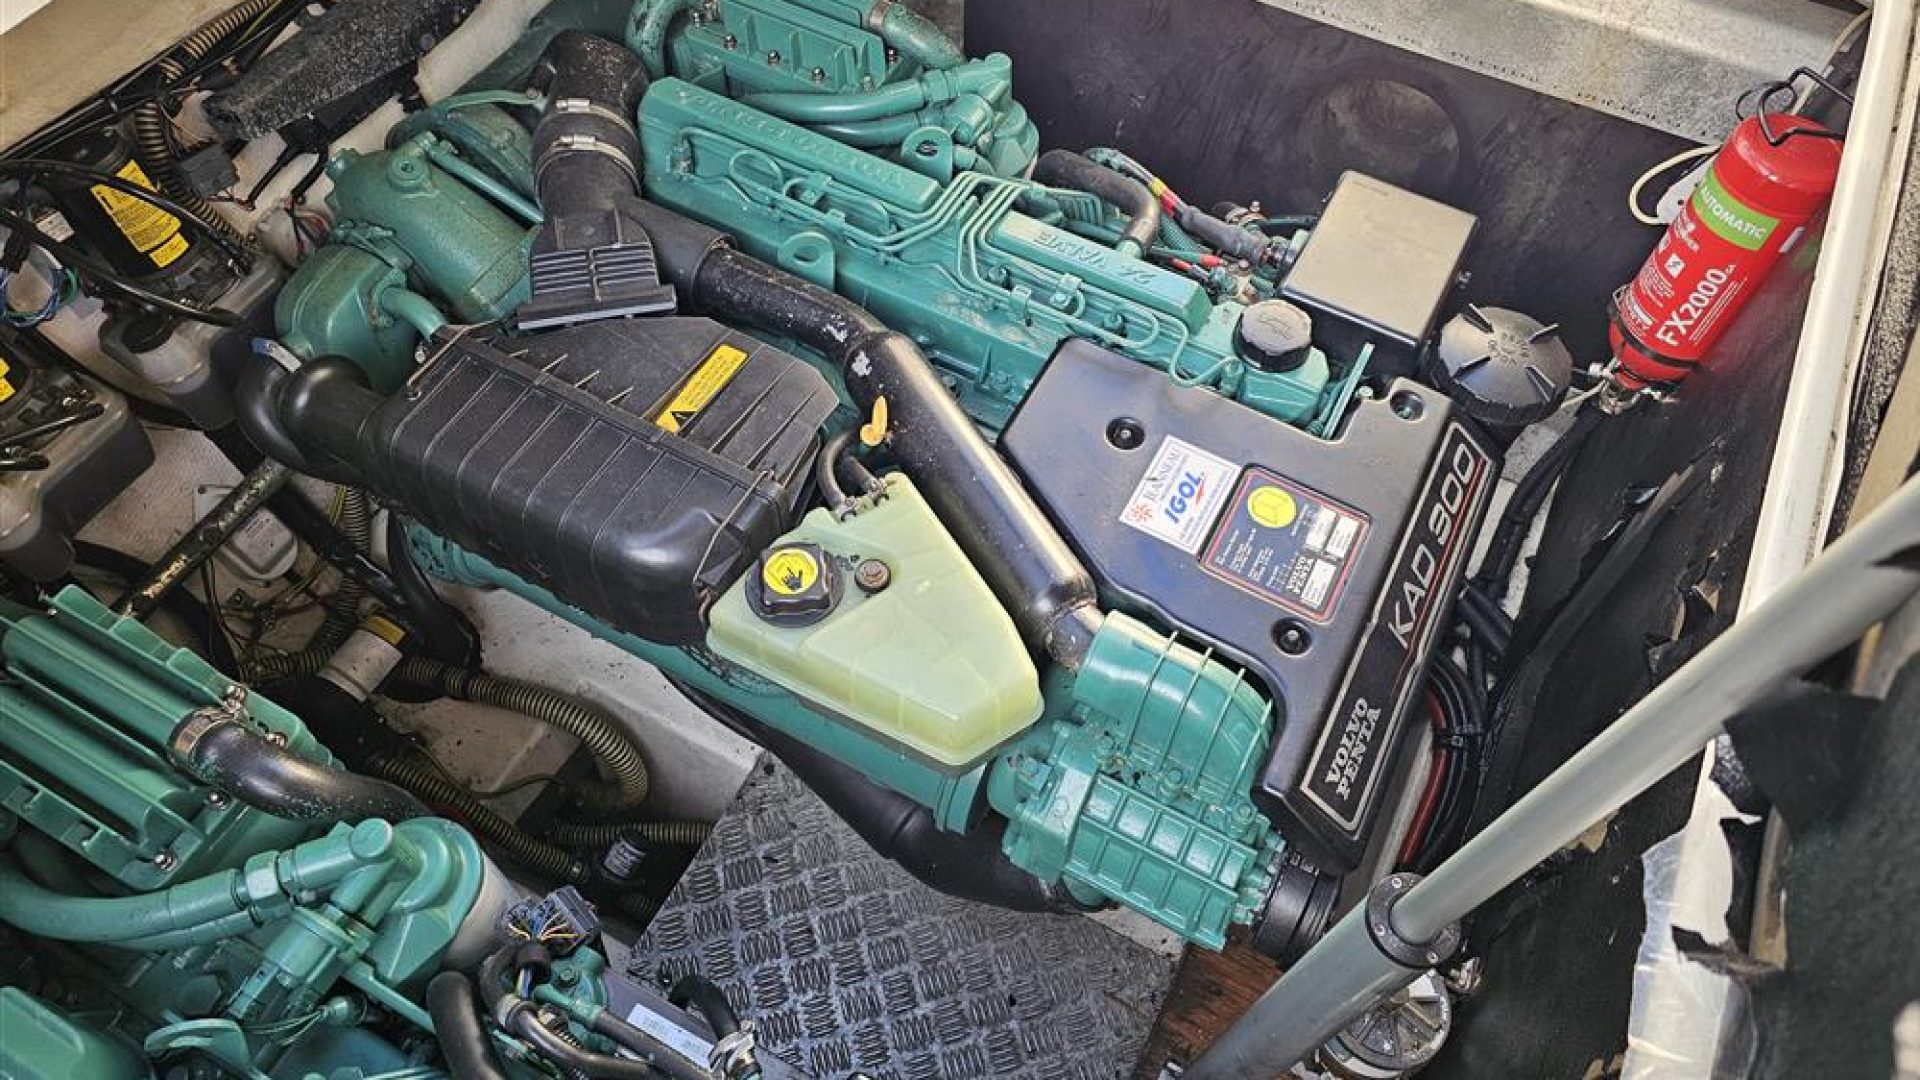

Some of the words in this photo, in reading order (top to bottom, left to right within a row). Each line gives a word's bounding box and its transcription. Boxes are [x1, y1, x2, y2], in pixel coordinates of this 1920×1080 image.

[1700, 184, 1768, 239] AUTOMATIC
[1655, 268, 1729, 346] FX2000
[1164, 472, 1203, 524] IGOL
[1387, 551, 1436, 649] KAD
[1428, 443, 1475, 546] 300
[1325, 697, 1371, 784] VOLVO
[1335, 705, 1381, 801] PENTA
